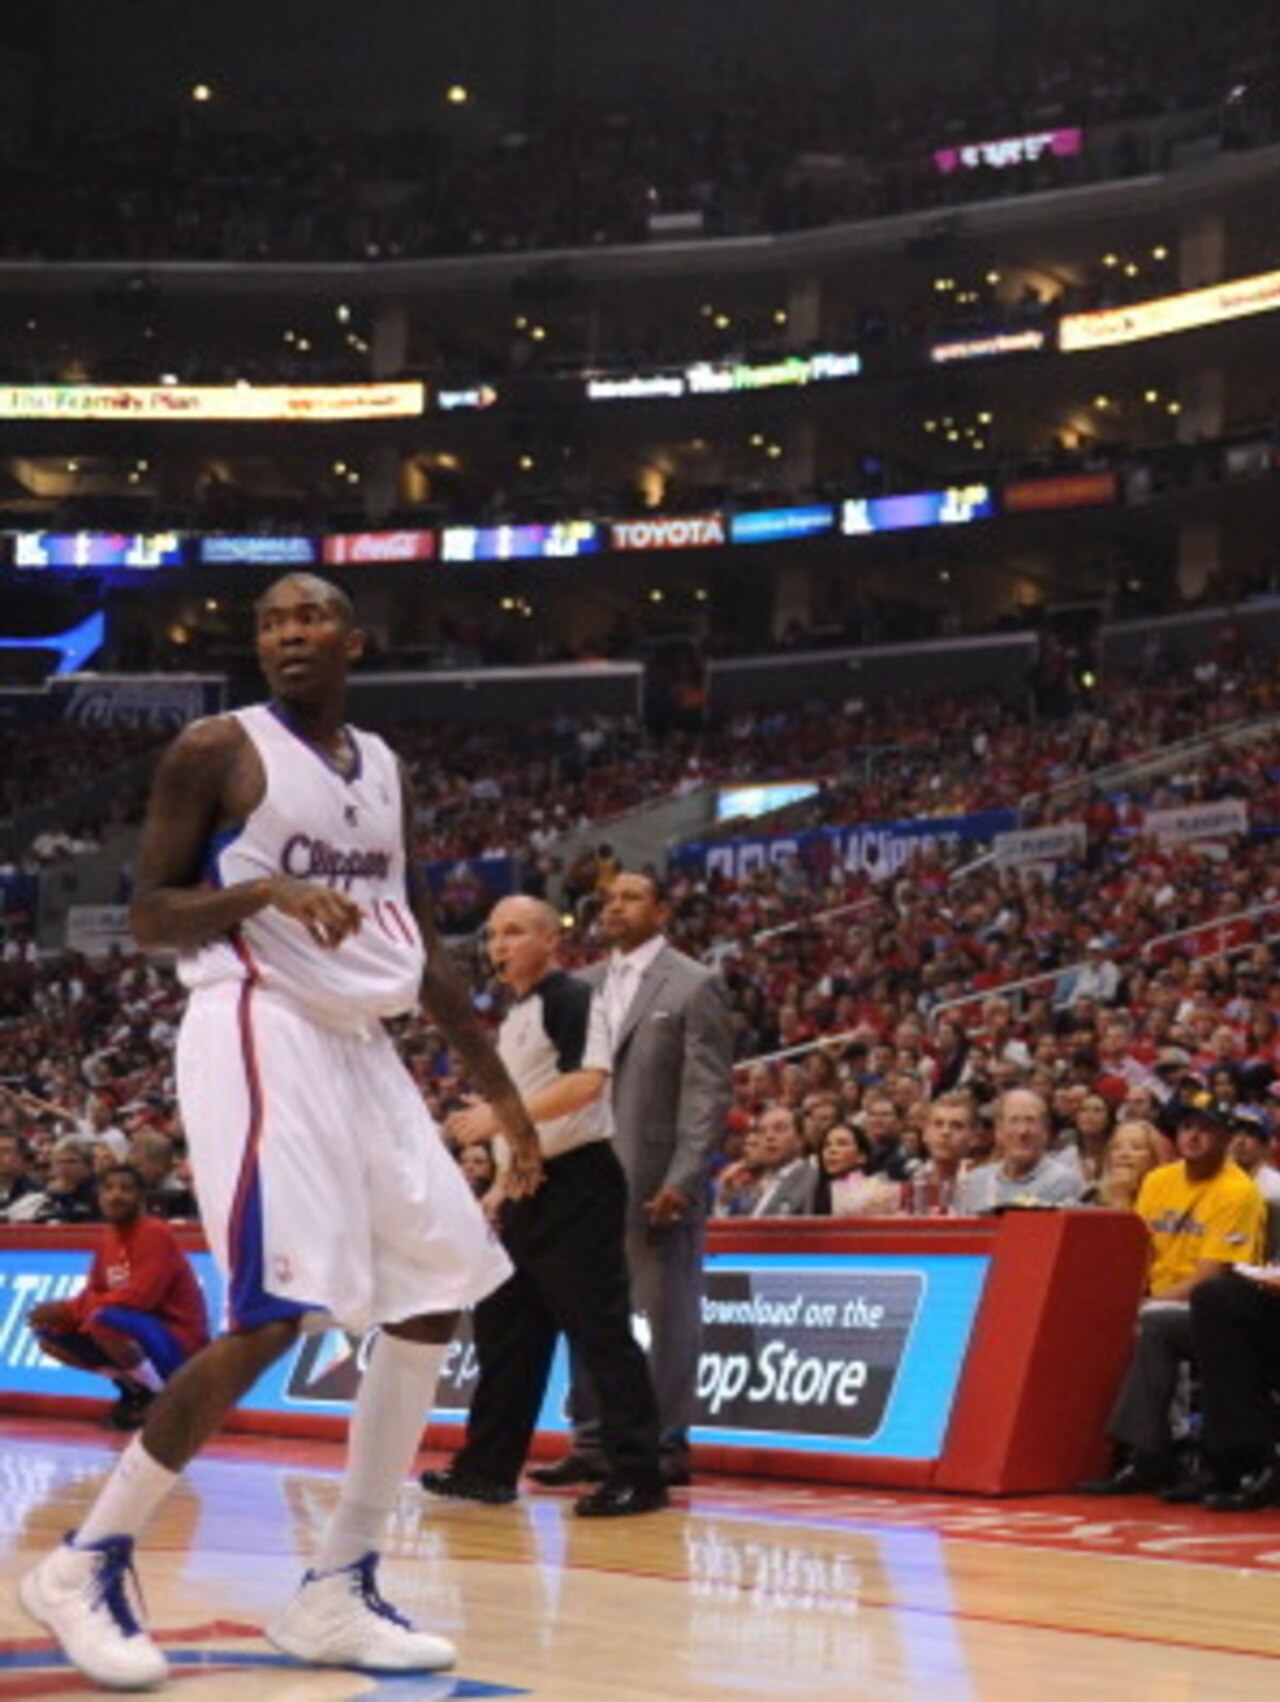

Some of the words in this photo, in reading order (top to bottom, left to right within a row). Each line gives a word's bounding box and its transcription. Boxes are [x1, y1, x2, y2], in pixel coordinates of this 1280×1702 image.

[612, 520, 724, 548] TOYOTA
[803, 1301, 835, 1327] on
[840, 1296, 885, 1329] the
[696, 1351, 750, 1415] pp
[747, 1339, 867, 1407] Store
